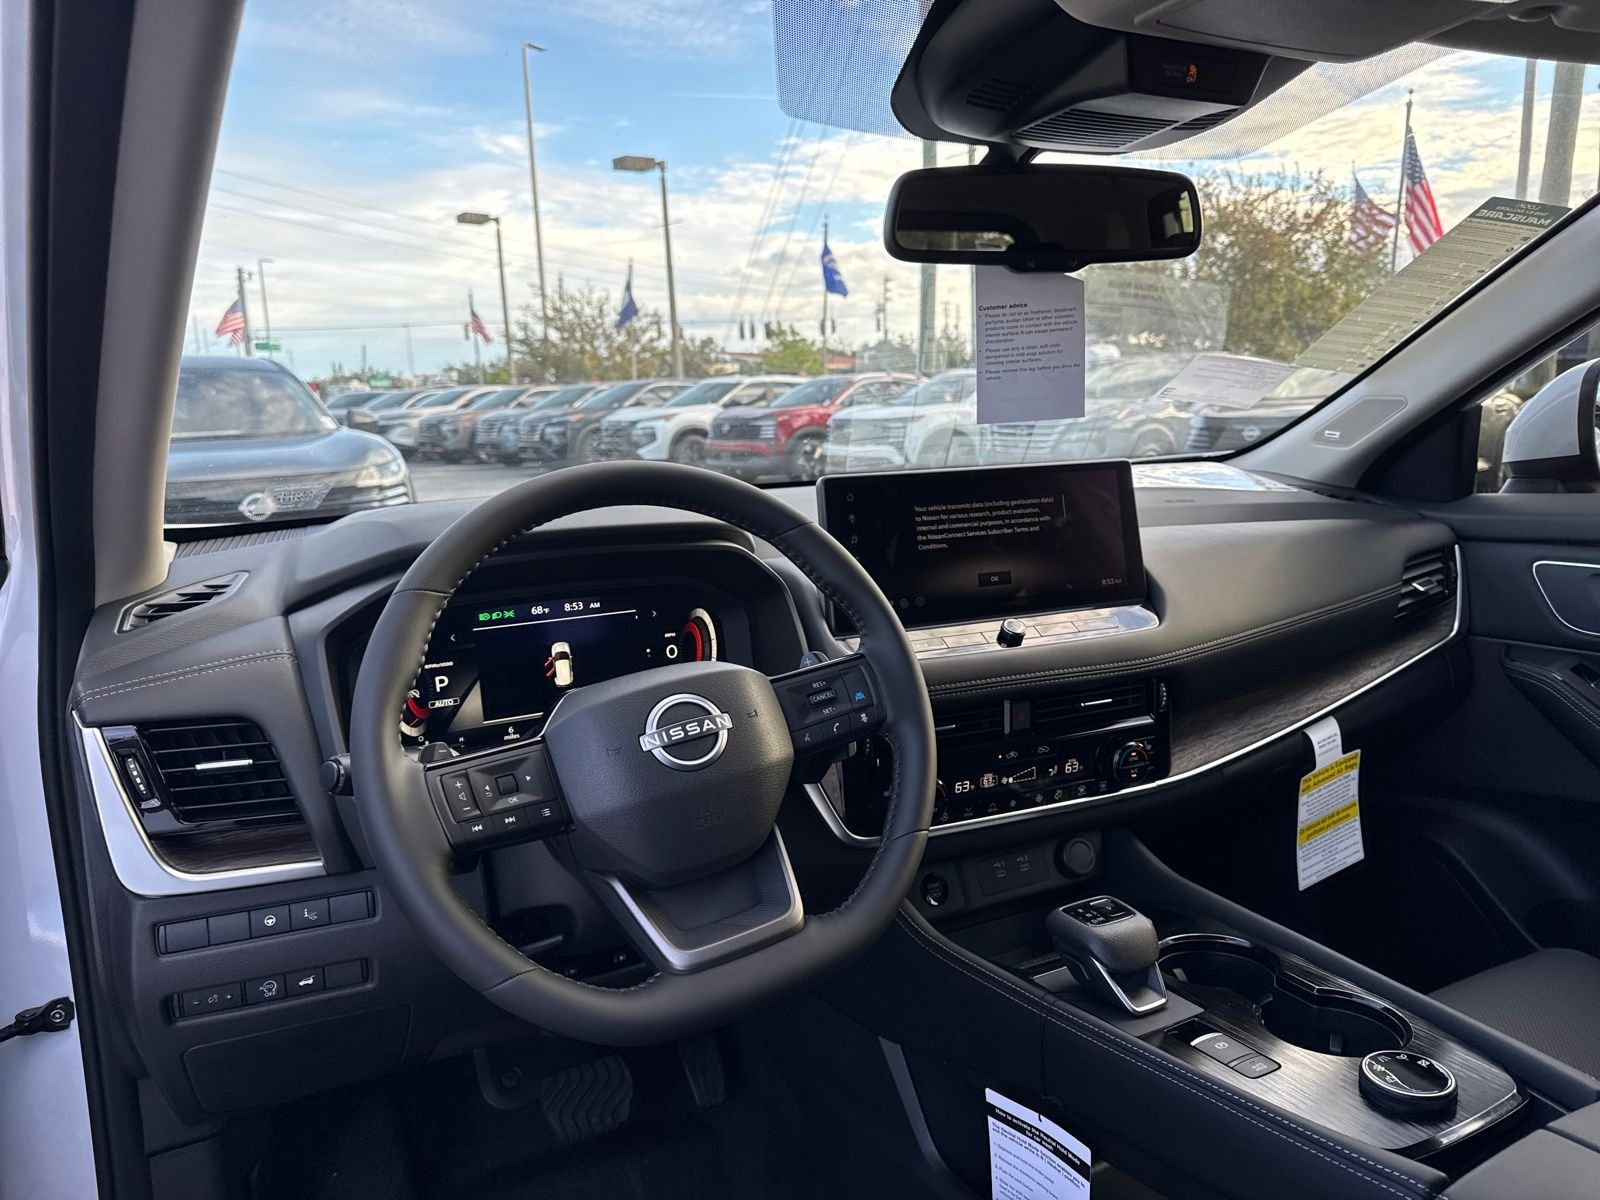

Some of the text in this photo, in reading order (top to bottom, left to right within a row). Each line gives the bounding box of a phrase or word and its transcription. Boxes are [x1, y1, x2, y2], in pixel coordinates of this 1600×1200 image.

[984, 500, 1010, 508] (including
[1011, 498, 1040, 506] geolocation
[564, 602, 584, 611] 8:53
[435, 675, 449, 692] P
[812, 691, 834, 702] CANCEL
[435, 699, 454, 707] AUTO
[644, 717, 731, 748] NISSAN
[996, 1108, 1006, 1117] How
[1012, 1118, 1030, 1130] activate
[1040, 1132, 1056, 1146] Neutral
[1056, 1144, 1067, 1155] Hold
[1068, 1152, 1080, 1165] Mode
